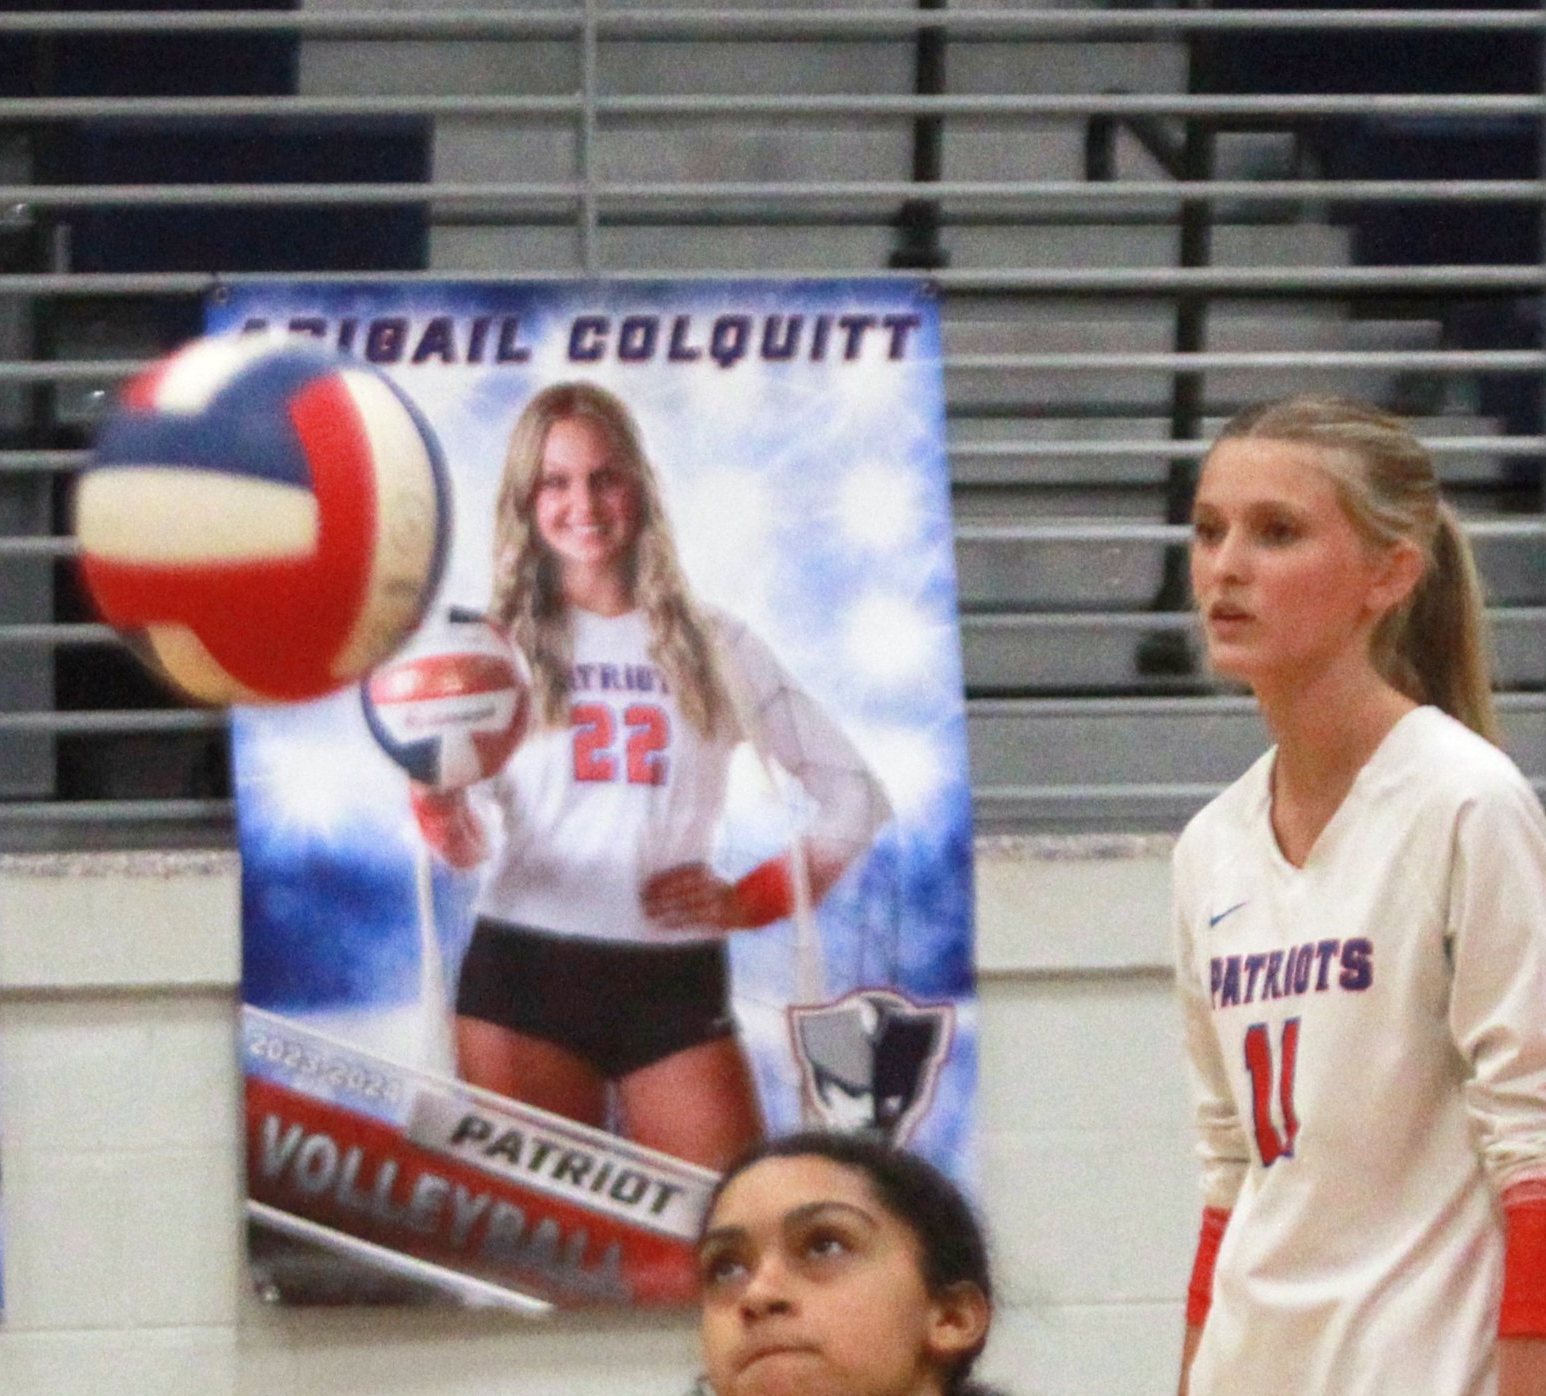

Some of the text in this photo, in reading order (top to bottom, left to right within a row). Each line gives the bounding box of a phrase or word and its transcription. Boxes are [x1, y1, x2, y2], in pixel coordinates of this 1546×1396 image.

[566, 313, 921, 369] COLQUITT
[570, 703, 671, 787] 22
[1209, 937, 1374, 1010] PATRIOTS
[1243, 1016, 1302, 1168] 11
[258, 1112, 635, 1300] VOLLEYBALL
[451, 1112, 684, 1219] PATRIOT
